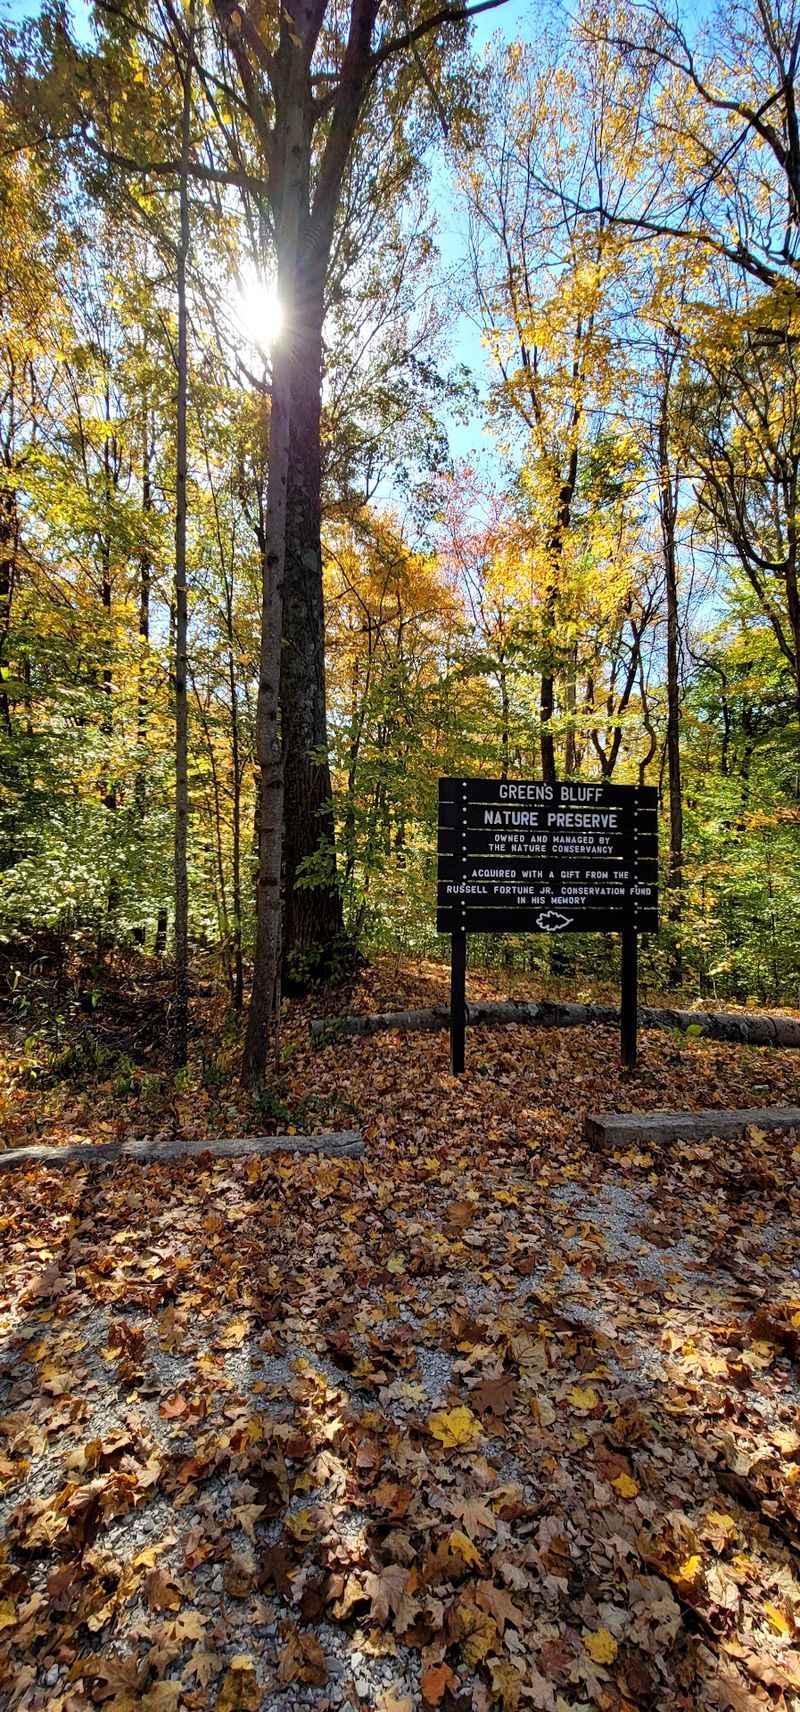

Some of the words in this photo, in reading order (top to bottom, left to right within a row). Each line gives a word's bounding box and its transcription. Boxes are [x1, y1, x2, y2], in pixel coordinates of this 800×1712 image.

[499, 783, 553, 800] GREEN'S
[561, 787, 604, 801] BLUFF
[484, 811, 538, 826] NATURE
[548, 813, 618, 828] PRESERVE
[495, 834, 525, 842] OWNED
[553, 836, 594, 844] MANAGED
[552, 845, 614, 854] CONSERVANCY
[471, 869, 516, 878] ACQUIRED
[522, 870, 543, 878] WITH
[586, 871, 608, 879] FROM
[614, 871, 629, 879] THE
[447, 885, 487, 893] RUSSELL
[494, 886, 534, 894] FORTUNE
[540, 887, 554, 895] JR.
[561, 887, 625, 895] CONSERVATION
[630, 887, 651, 895] FUND
